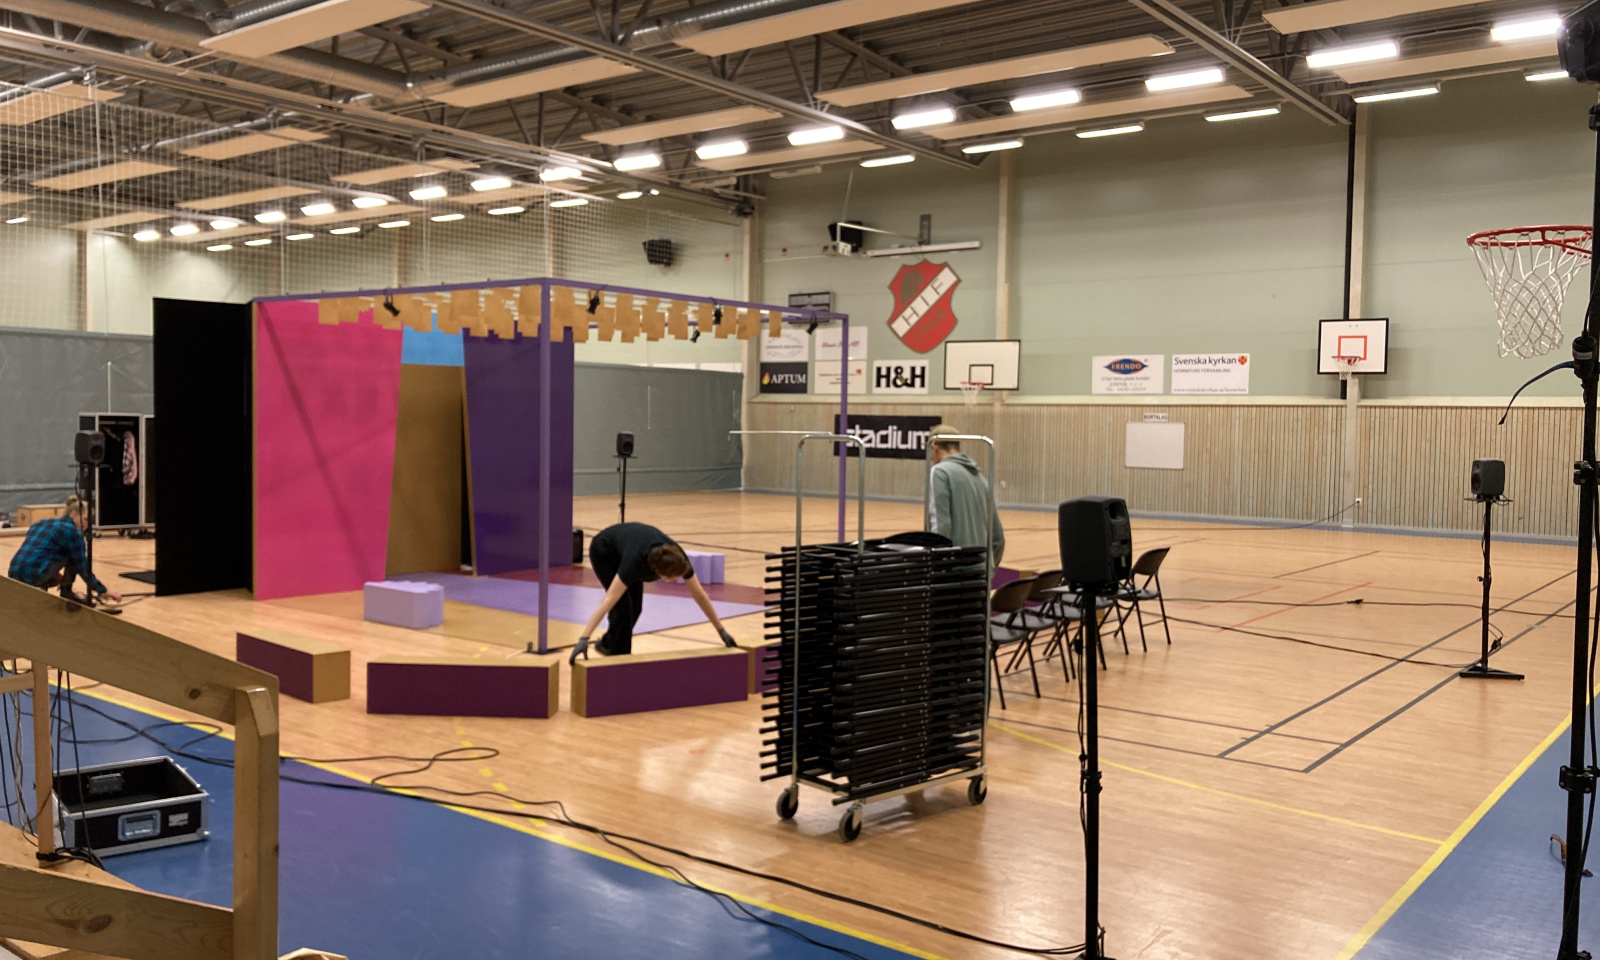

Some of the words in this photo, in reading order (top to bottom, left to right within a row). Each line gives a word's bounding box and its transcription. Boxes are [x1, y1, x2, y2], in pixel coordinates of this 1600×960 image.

[901, 277, 944, 327] HIF
[1174, 356, 1207, 365] Svenska
[1208, 356, 1237, 366] kyrkan
[771, 373, 806, 384] APTUM
[875, 366, 926, 388] H&H
